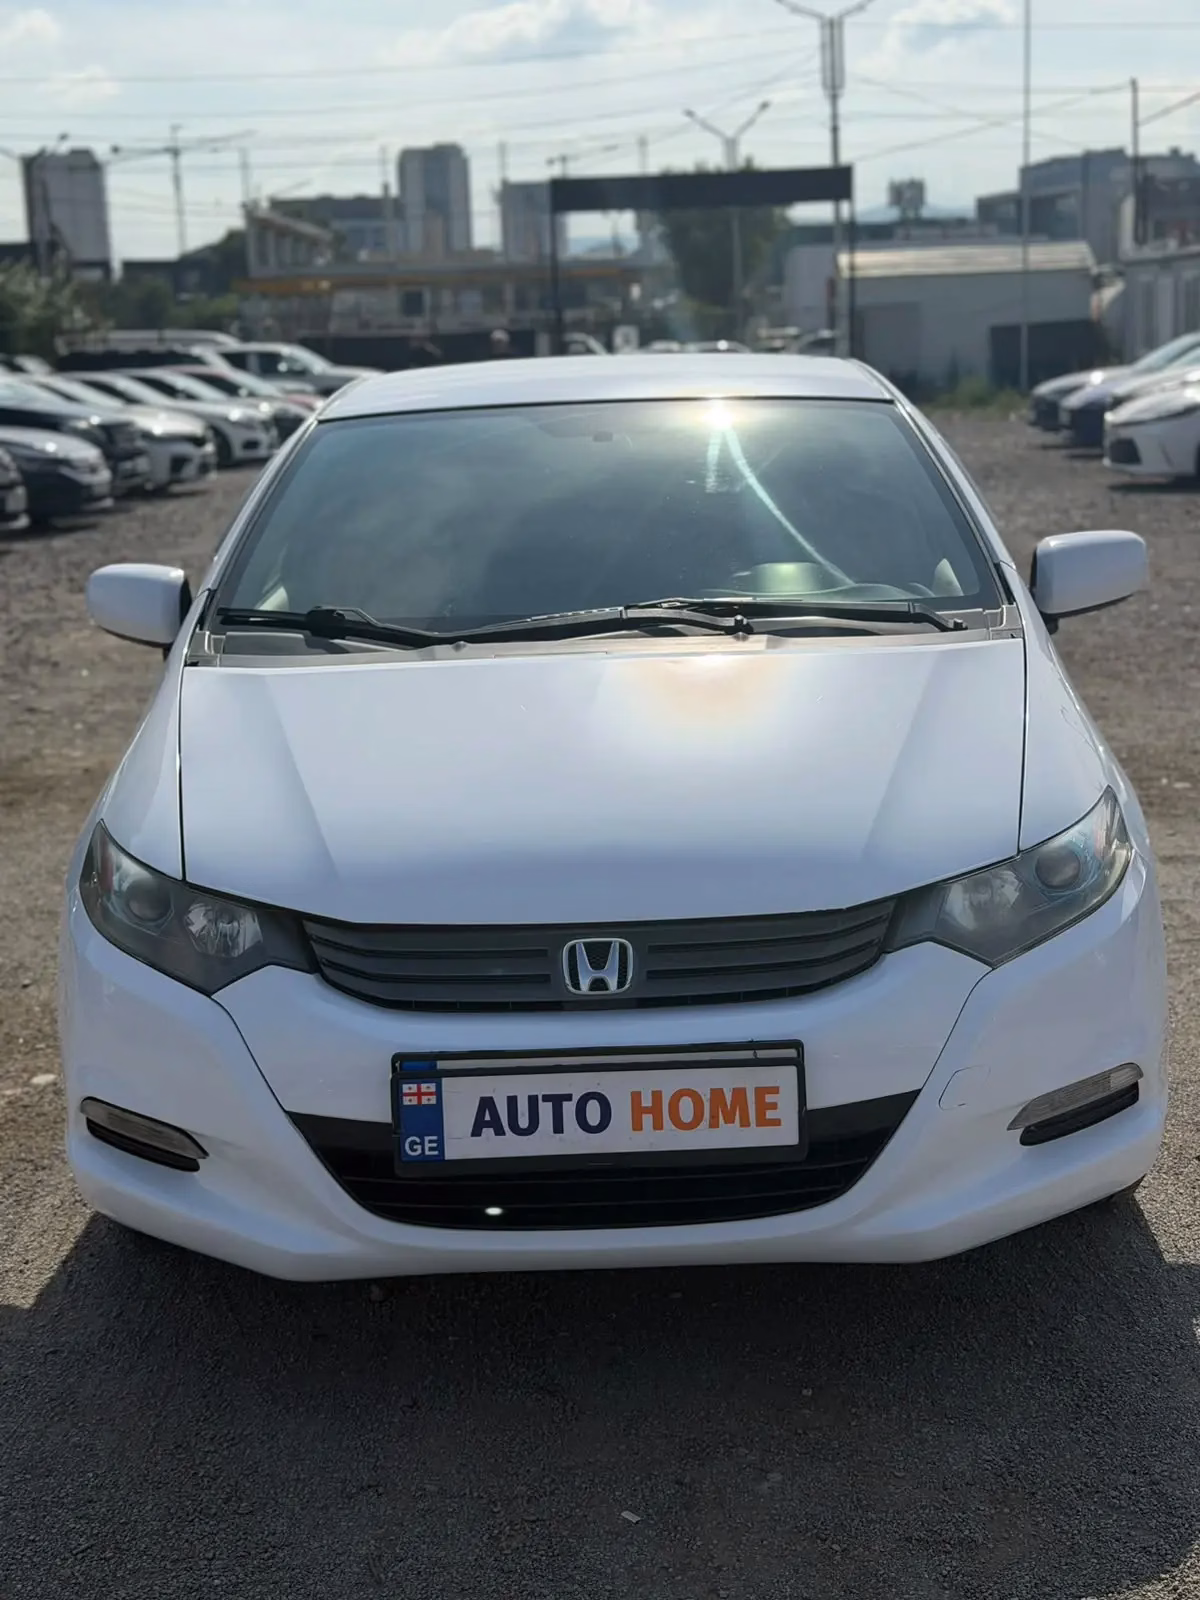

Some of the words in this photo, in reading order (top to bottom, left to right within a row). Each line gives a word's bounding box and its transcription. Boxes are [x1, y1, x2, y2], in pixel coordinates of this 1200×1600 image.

[470, 1091, 612, 1137] AUTO
[630, 1086, 782, 1132] HOME
[404, 1136, 439, 1156] GE
